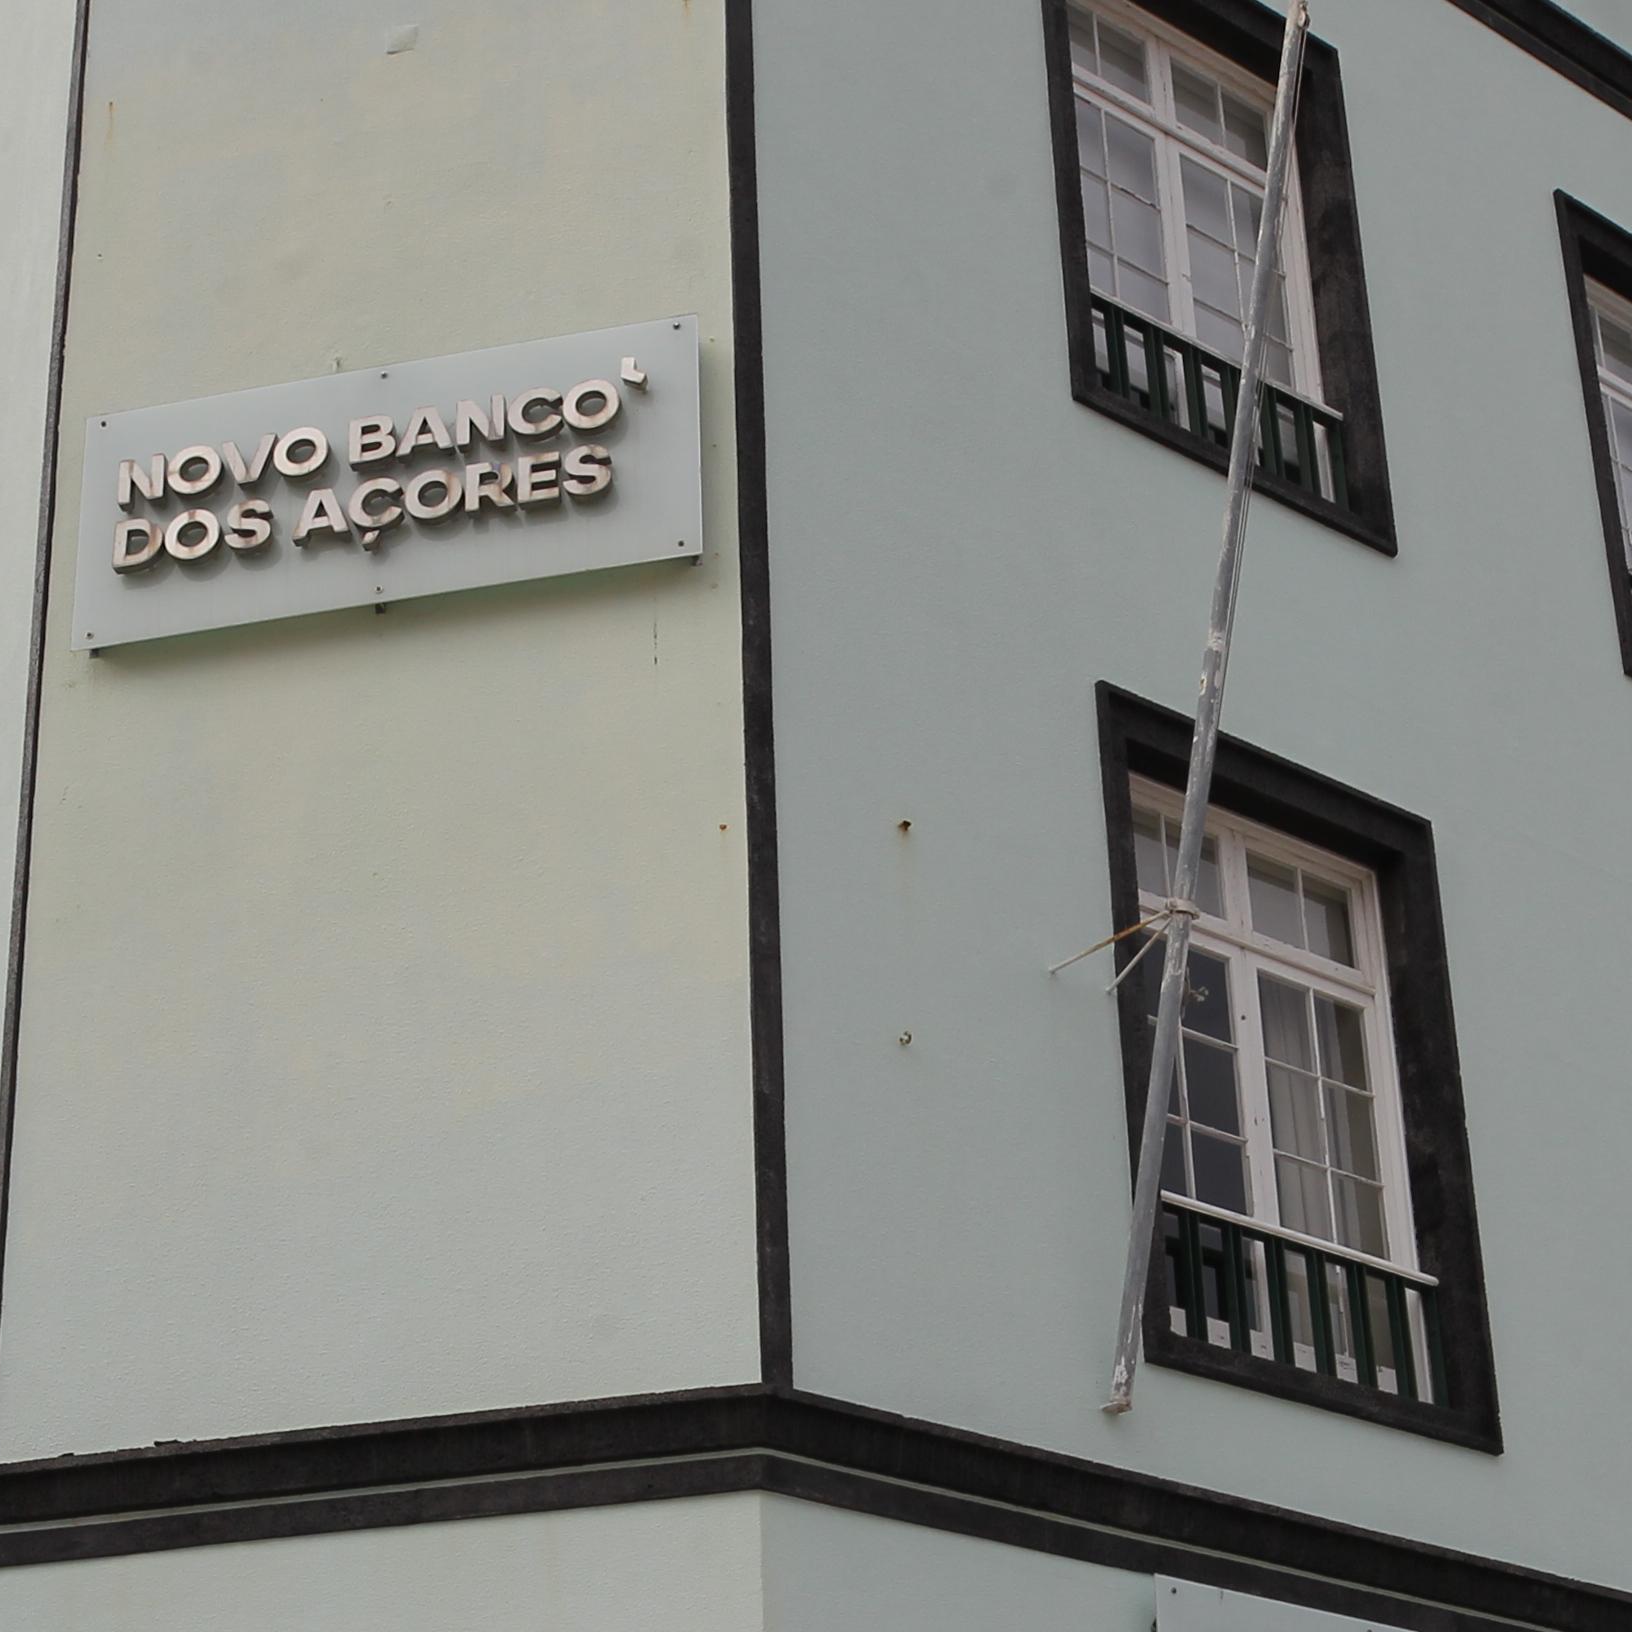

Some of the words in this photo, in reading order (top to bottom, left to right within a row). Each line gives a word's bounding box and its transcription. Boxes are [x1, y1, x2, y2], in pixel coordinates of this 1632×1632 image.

[112, 497, 274, 575] DOS
[291, 443, 613, 552] AÇORES
[117, 426, 332, 511] NOVO
